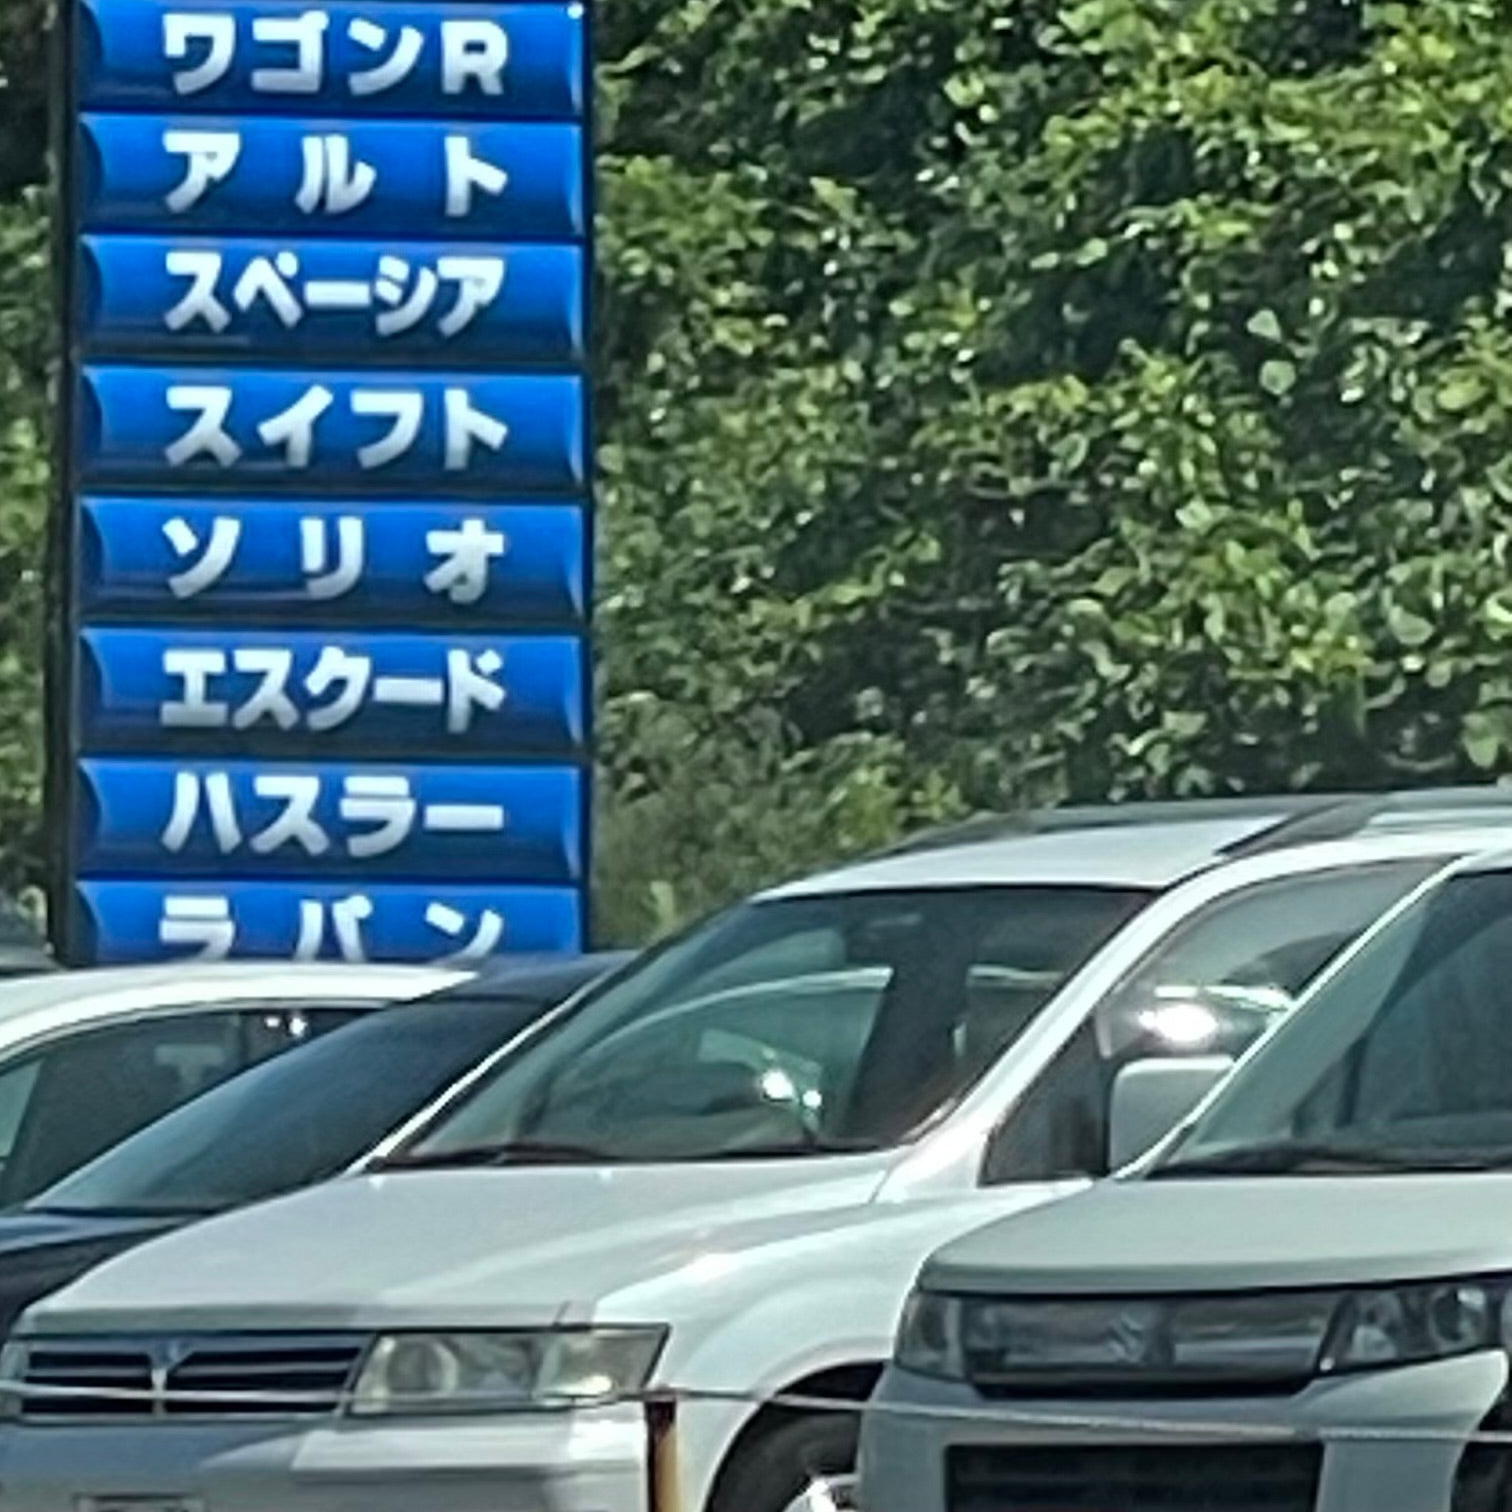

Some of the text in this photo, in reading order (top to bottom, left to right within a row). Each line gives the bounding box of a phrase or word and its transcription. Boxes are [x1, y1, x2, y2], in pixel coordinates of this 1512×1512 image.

[162, 9, 509, 97] ワゴンR
[162, 129, 509, 217] アルト
[163, 250, 506, 338] スペーシア
[164, 384, 509, 472] スイフト
[161, 515, 506, 605] ソリオ
[159, 645, 507, 735] エスクード
[160, 770, 506, 858] ハスラー
